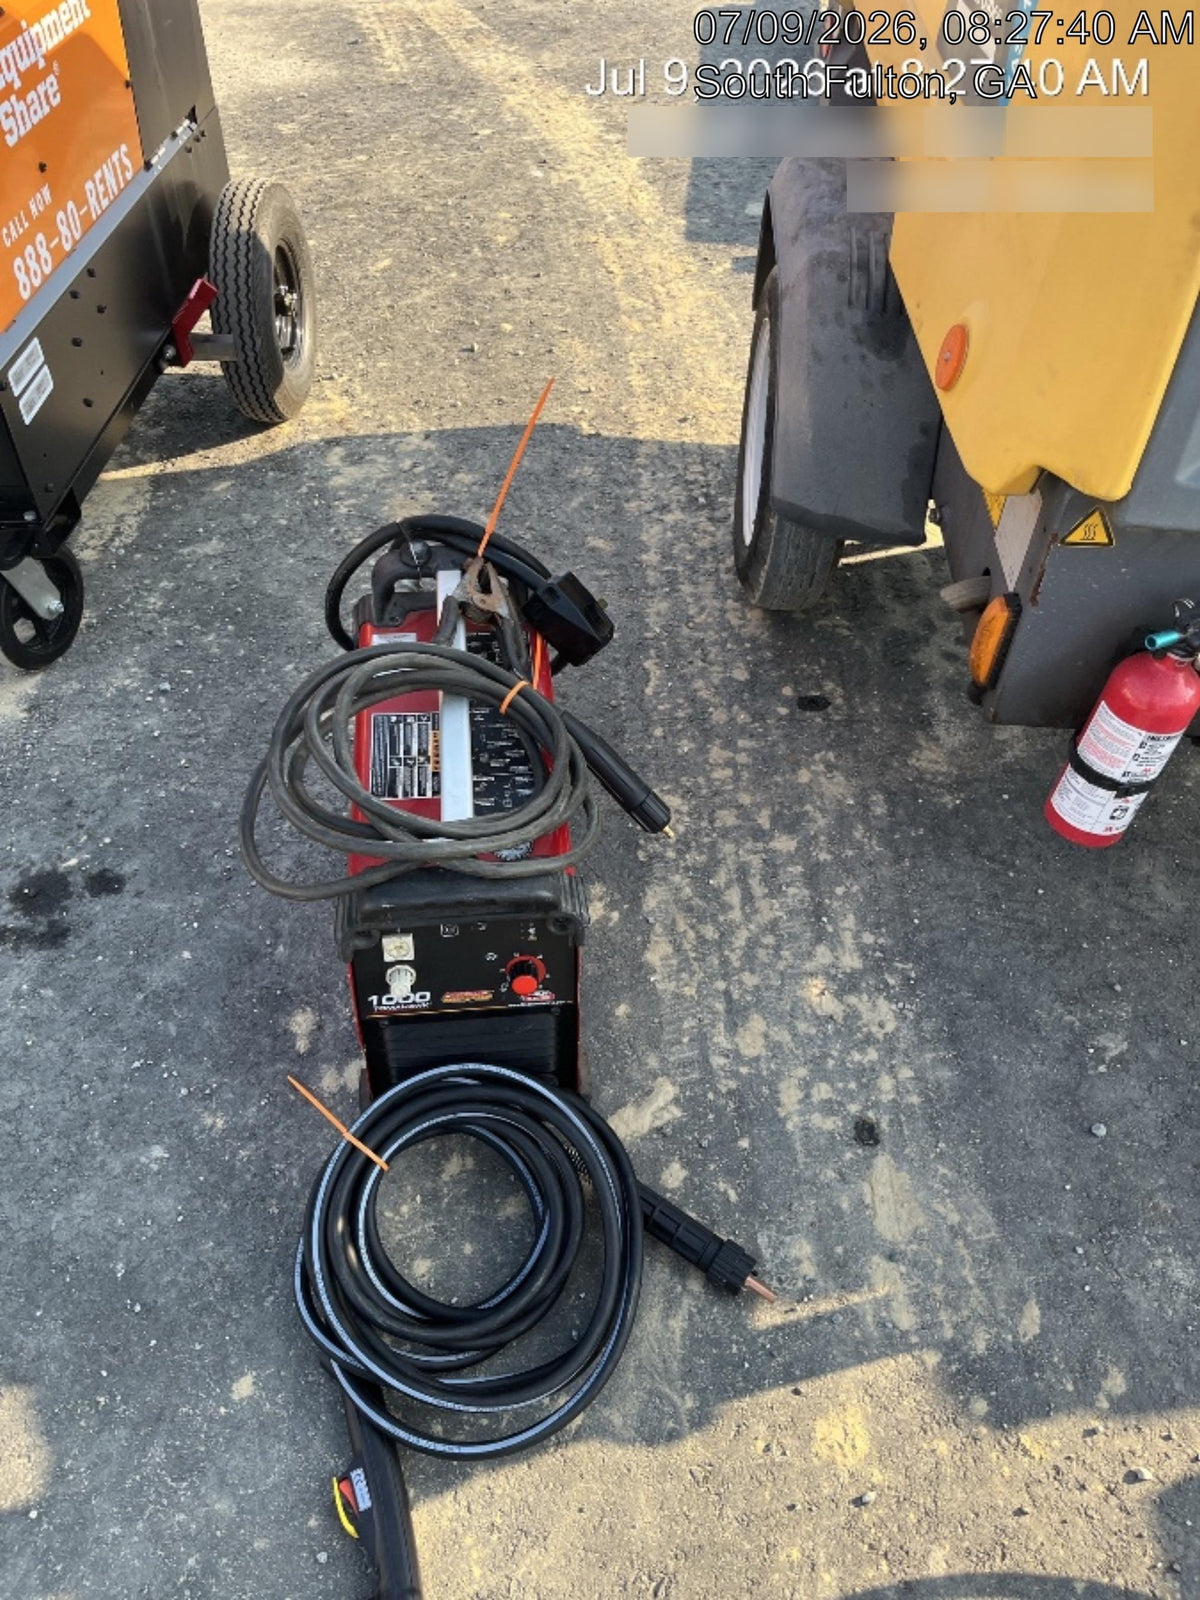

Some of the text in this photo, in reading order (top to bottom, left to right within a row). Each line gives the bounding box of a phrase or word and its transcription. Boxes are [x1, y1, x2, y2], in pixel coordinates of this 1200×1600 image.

[0, 0, 92, 90] quipment
[2, 183, 52, 248] CALL NOW
[13, 143, 134, 301] 888-80-RENTS
[367, 991, 431, 1007] 1000
